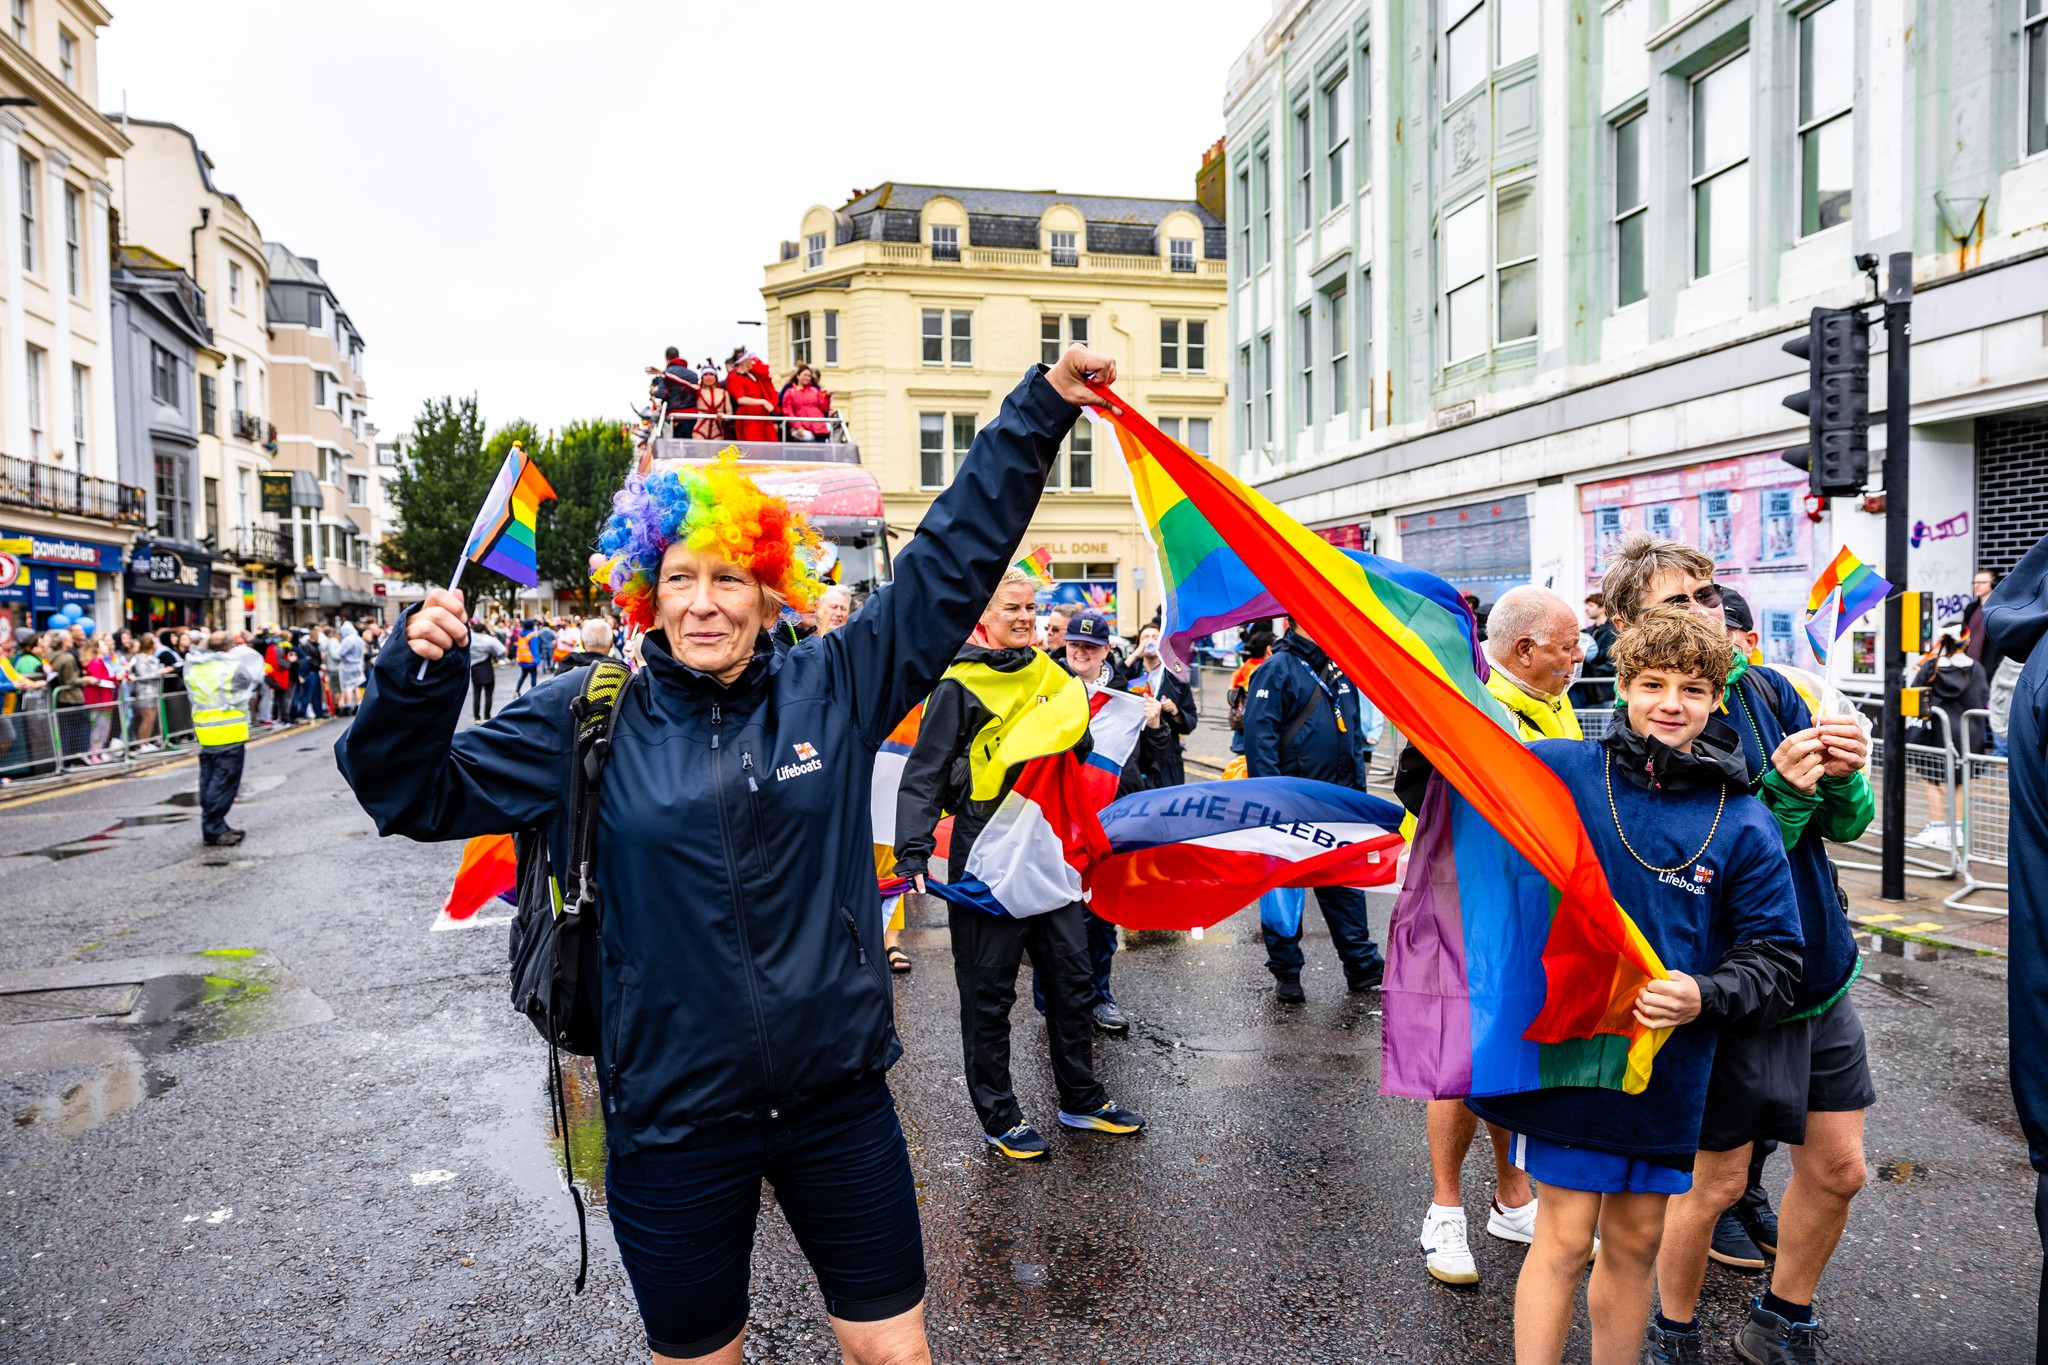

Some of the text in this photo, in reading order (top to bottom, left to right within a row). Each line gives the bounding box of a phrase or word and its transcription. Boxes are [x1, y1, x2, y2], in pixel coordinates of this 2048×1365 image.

[1071, 542, 1109, 554] DONE
[776, 759, 822, 781] Lifeboats
[1658, 872, 1706, 895] Lifeboats
